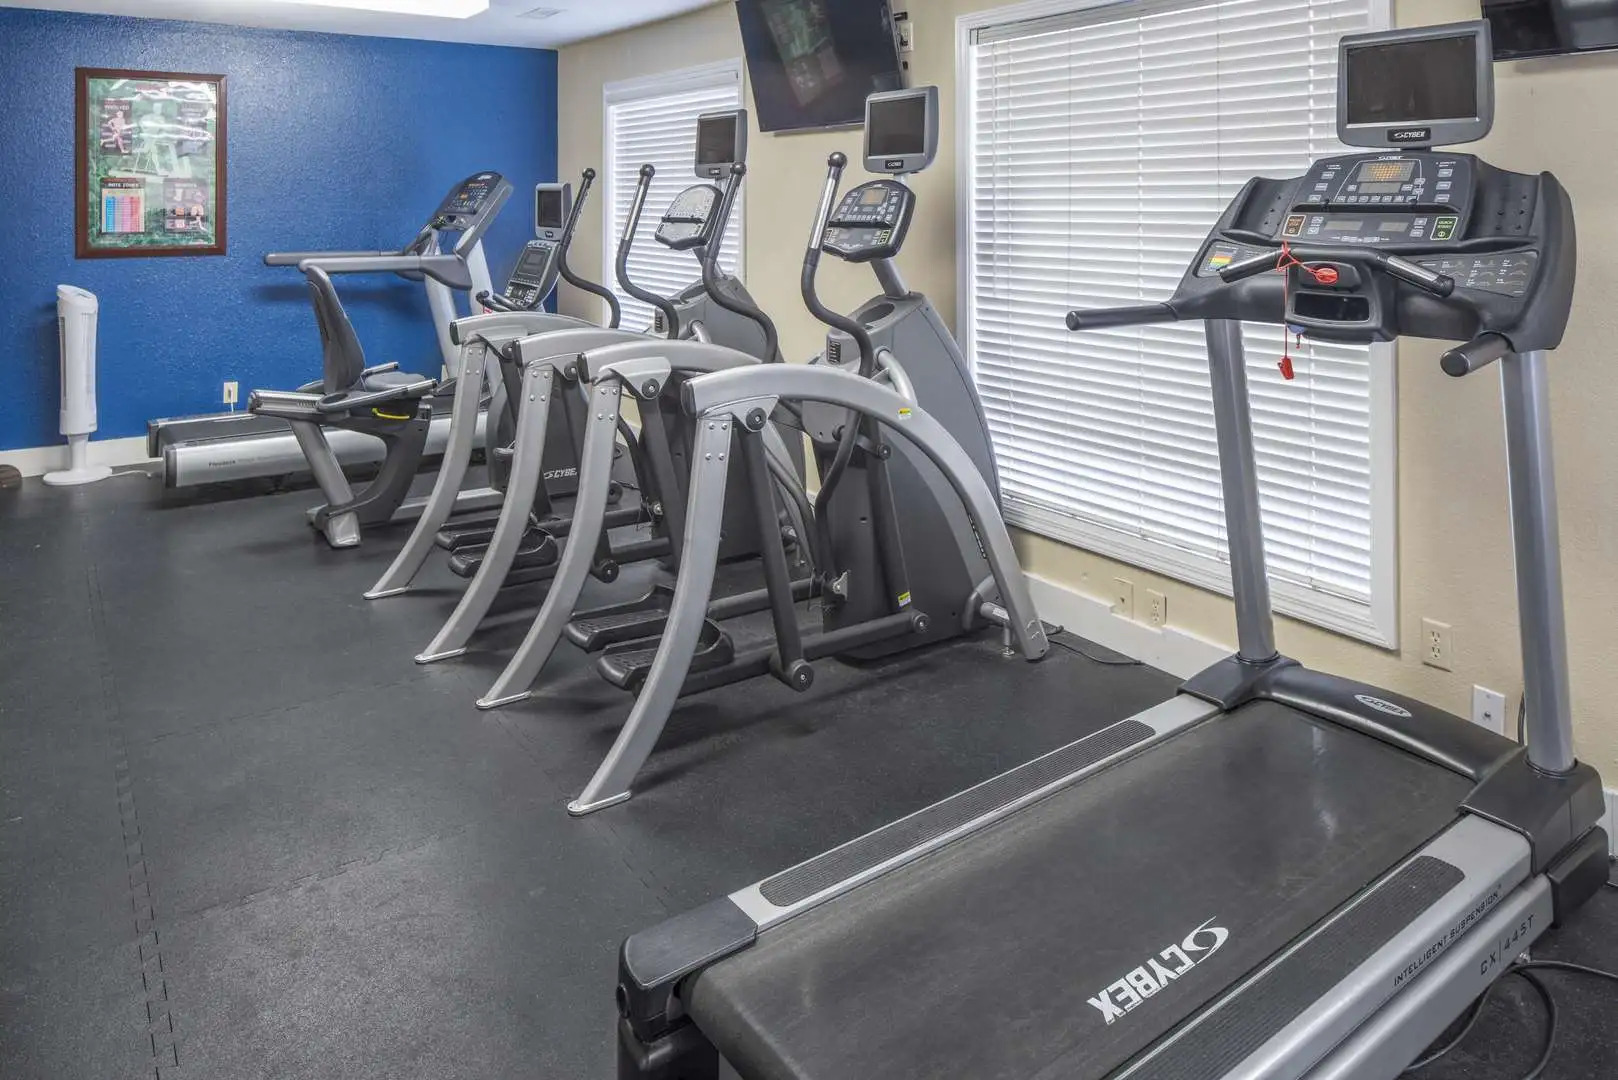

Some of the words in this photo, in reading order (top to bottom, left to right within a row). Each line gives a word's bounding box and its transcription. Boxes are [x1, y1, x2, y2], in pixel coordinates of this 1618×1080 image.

[554, 468, 577, 478] CYBE
[1087, 943, 1196, 1025] CYBEX
[1394, 935, 1448, 986] INTELLIGENT
